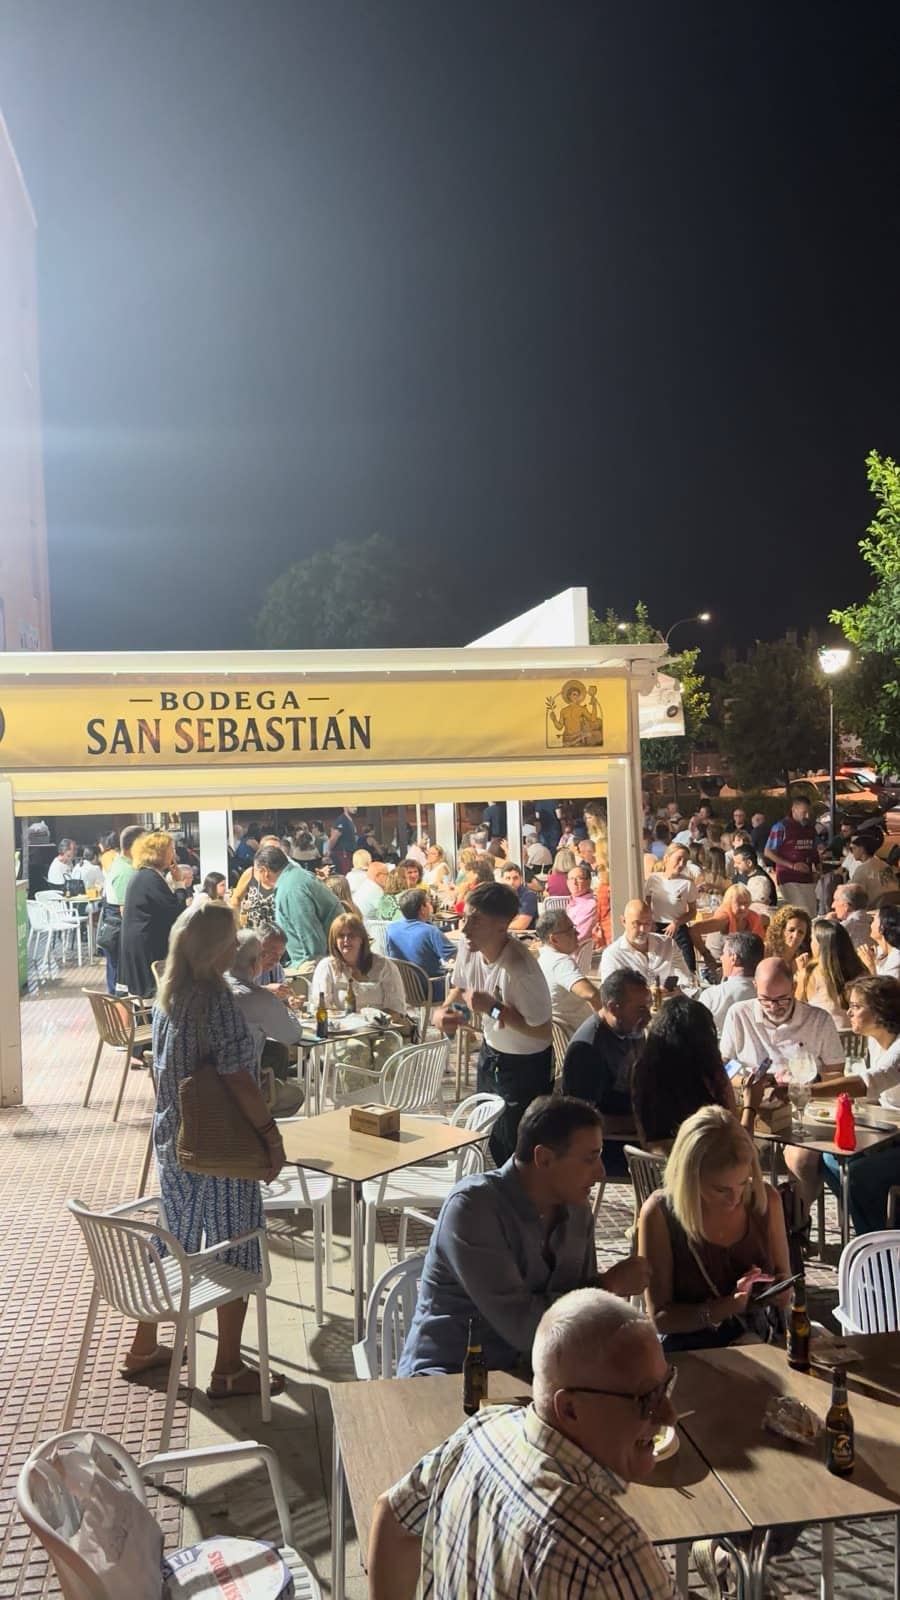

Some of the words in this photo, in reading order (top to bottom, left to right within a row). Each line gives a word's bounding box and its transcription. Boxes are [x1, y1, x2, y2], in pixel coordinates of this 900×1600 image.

[160, 690, 300, 711] BODEGA
[87, 718, 162, 755] SAN
[174, 708, 371, 754] SEBASTIÁN
